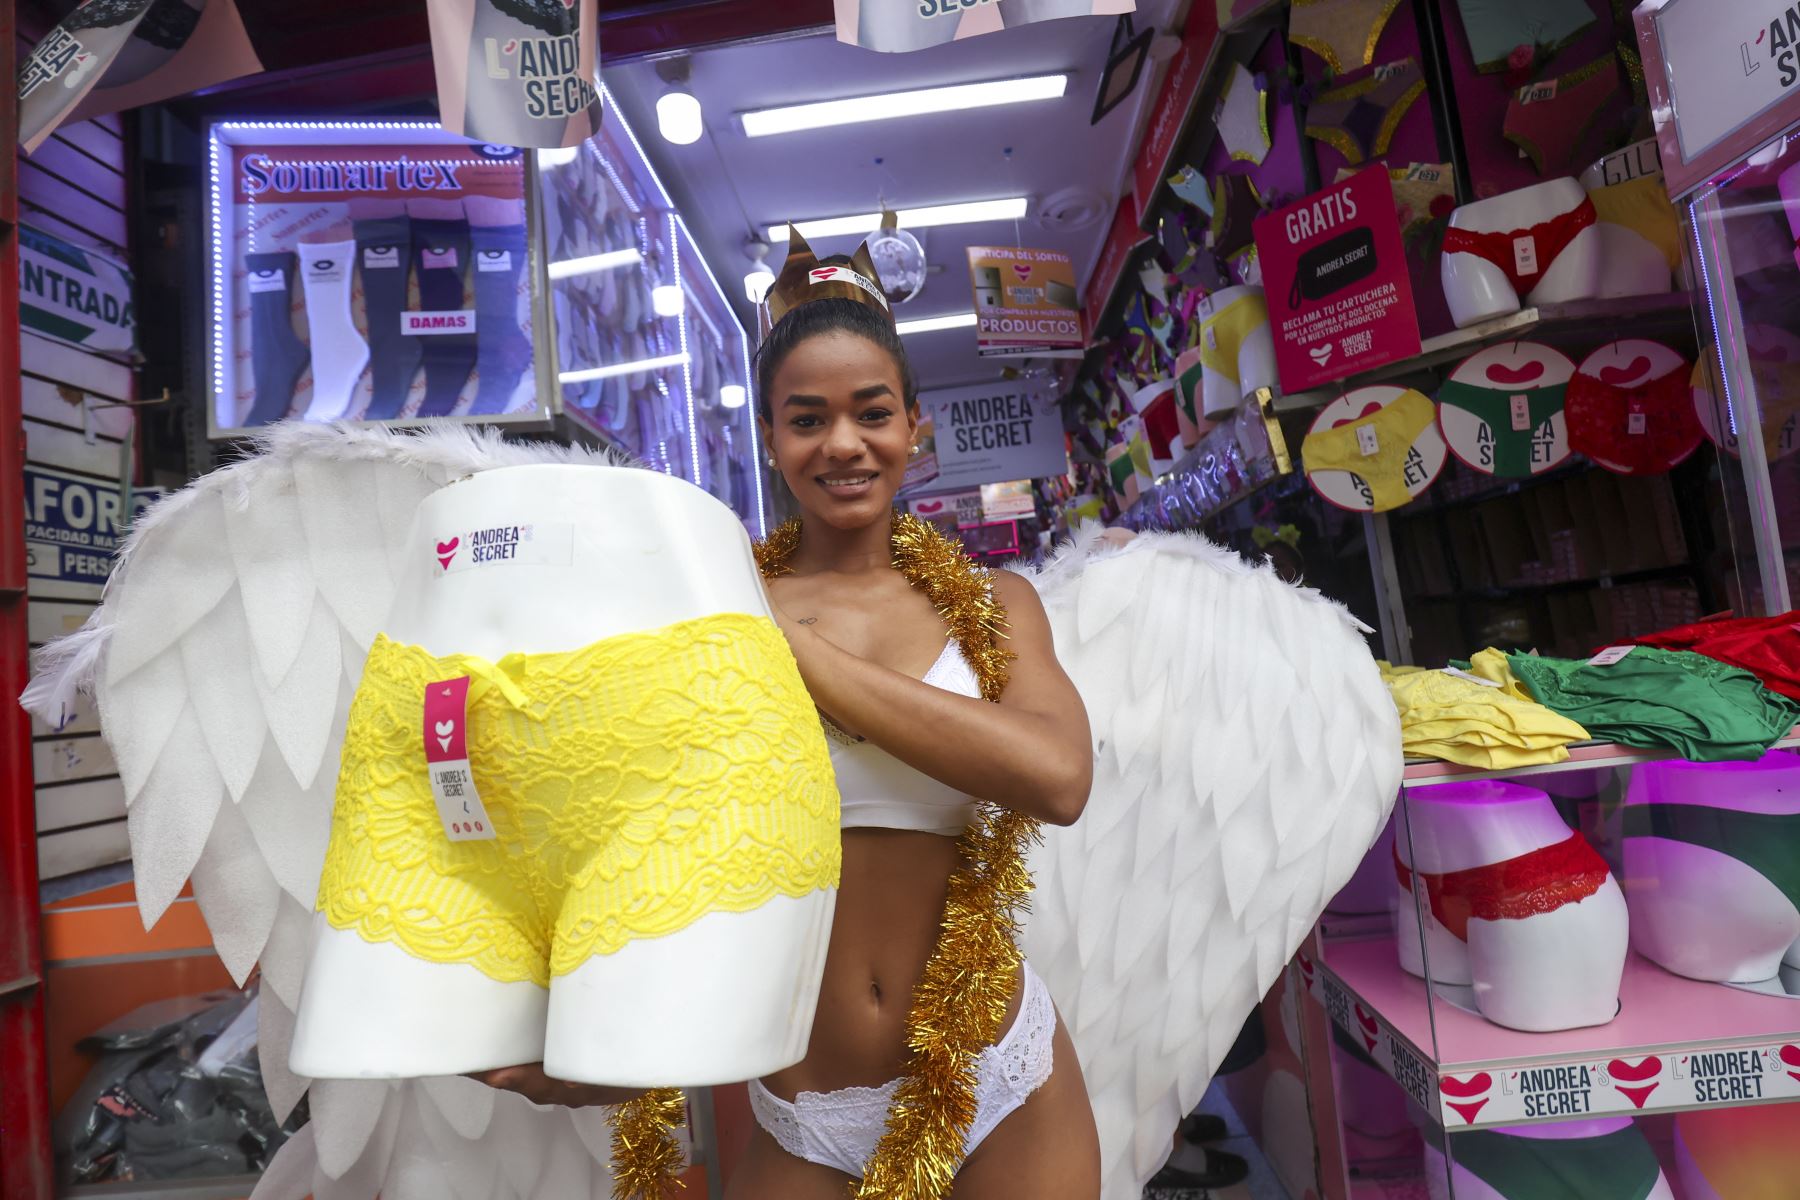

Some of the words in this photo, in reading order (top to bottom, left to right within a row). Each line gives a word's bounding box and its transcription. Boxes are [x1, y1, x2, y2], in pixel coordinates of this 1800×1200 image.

[241, 154, 463, 193] Somartex
[1285, 187, 1357, 244] GRATIS
[1316, 257, 1344, 278] ANDREA
[1344, 244, 1368, 265] SECRET
[19, 258, 135, 328] NTRADA
[1282, 310, 1322, 332] RECLAMA
[1323, 304, 1335, 316] TU
[1336, 282, 1396, 312] CARTUCHERA
[410, 316, 466, 328] DAMAS
[980, 319, 1078, 334] PRODUCTOS
[1284, 330, 1298, 342] POR
[1298, 325, 1308, 337] LA
[1308, 317, 1337, 332] COMPRA
[1338, 312, 1347, 323] DE
[1348, 307, 1363, 319] DOS
[1364, 295, 1398, 313] DOCENAS
[1297, 334, 1307, 346] EN
[1307, 324, 1343, 343] NUESTROS
[1344, 308, 1387, 330] PRODUCTOS
[1344, 341, 1372, 358] SECRET
[956, 420, 1033, 453] SECRET
[472, 542, 518, 563] SECRET
[443, 783, 464, 797] SECRET
[1394, 1060, 1429, 1110] SECRET
[1694, 1074, 1763, 1103] SECRET
[1524, 1089, 1591, 1118] SECRET
